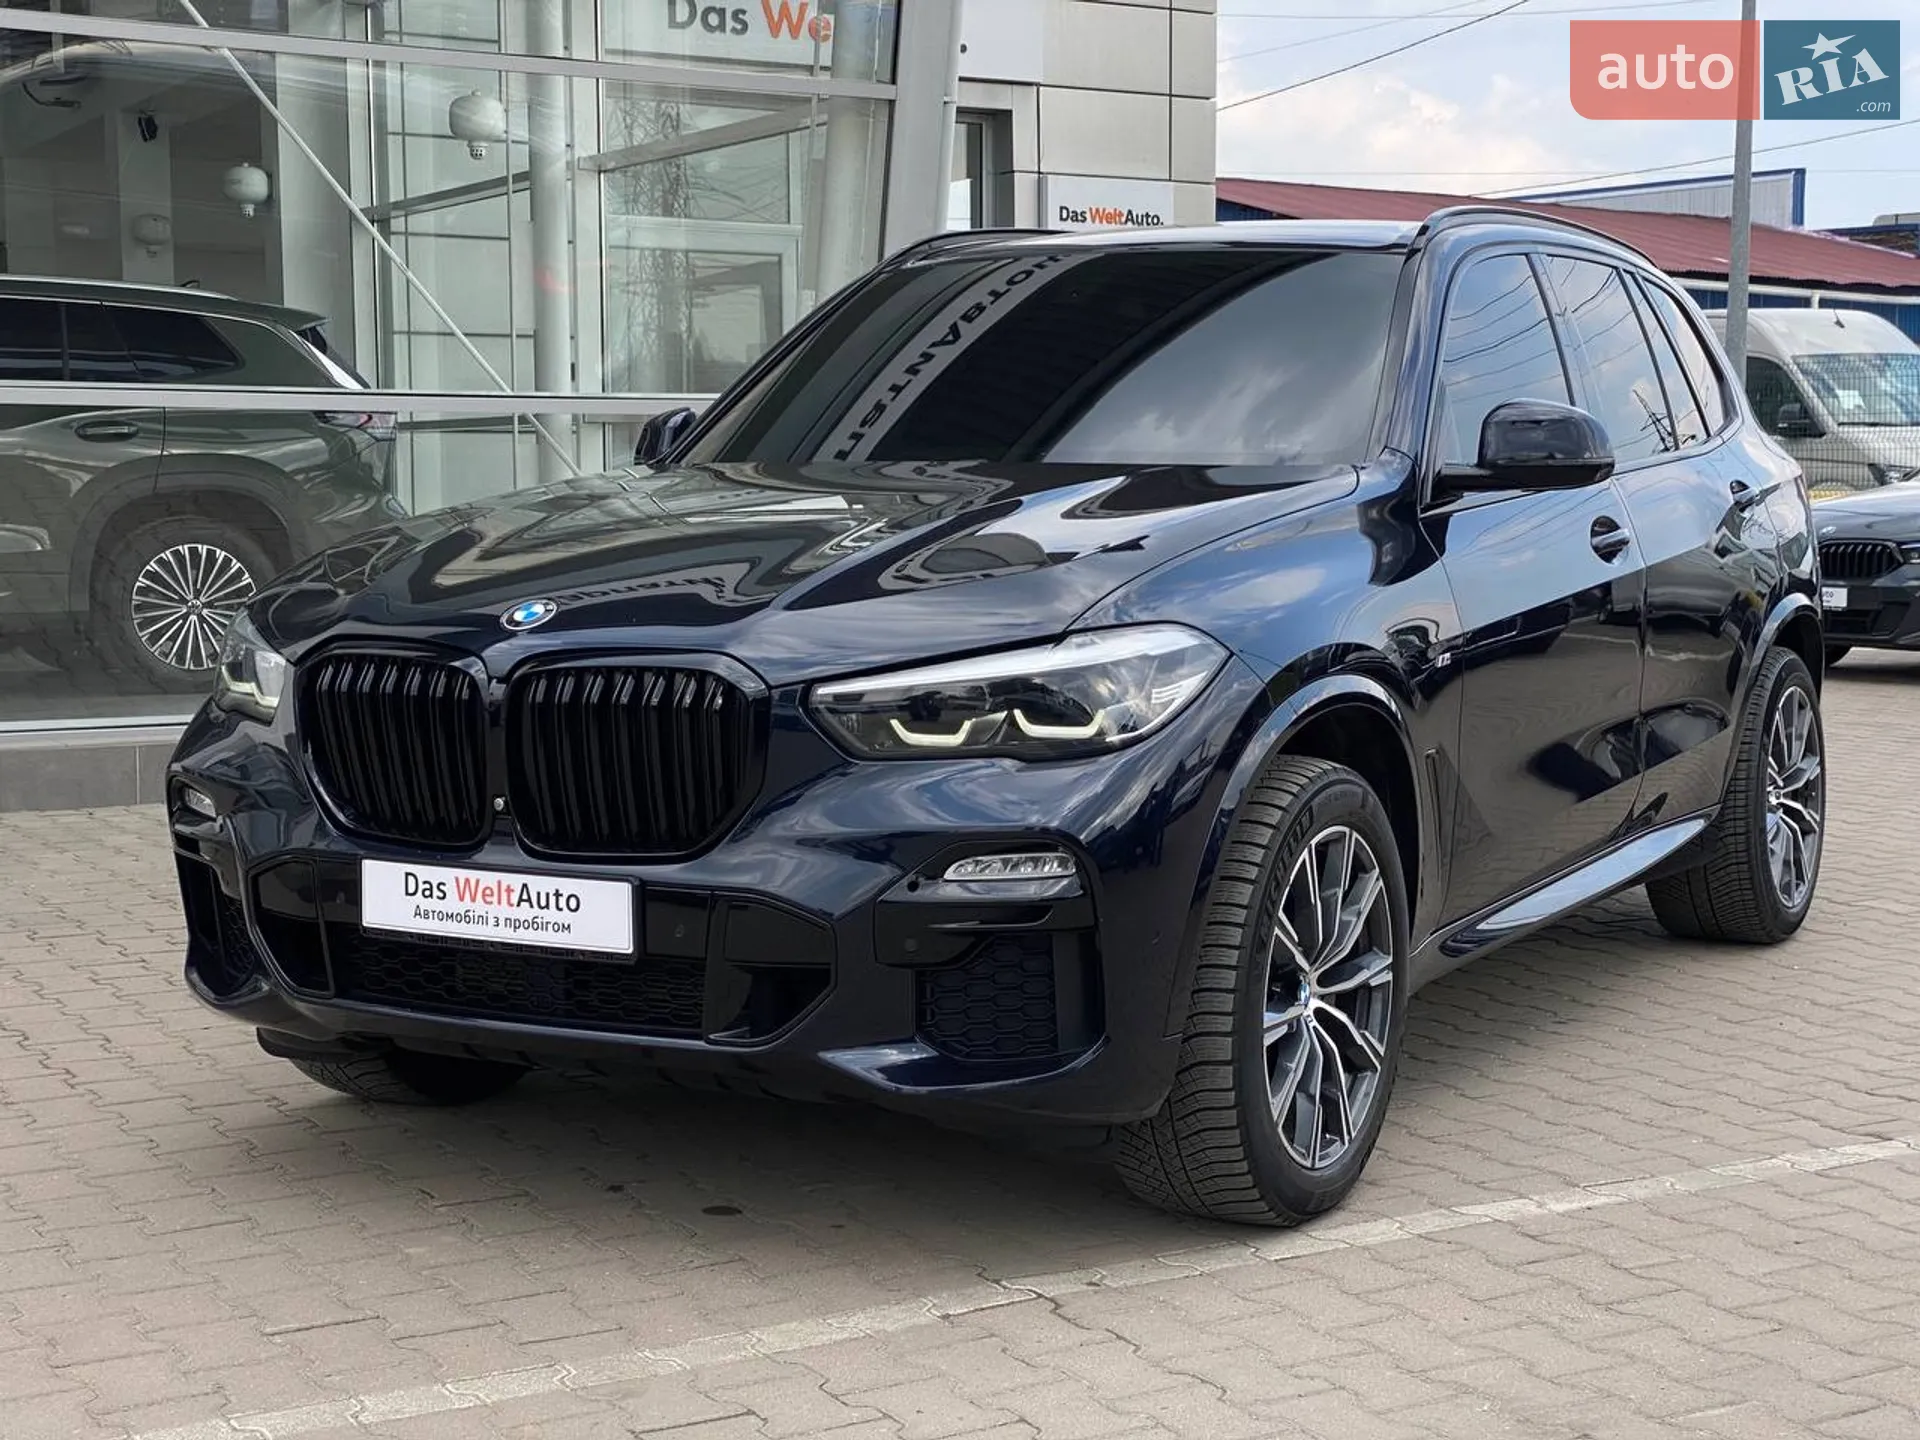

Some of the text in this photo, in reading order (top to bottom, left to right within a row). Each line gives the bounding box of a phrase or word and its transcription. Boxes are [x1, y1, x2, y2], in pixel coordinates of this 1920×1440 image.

[667, 0, 749, 36] Das
[1059, 206, 1164, 226] Das WeltAuto.
[404, 872, 581, 913] Das WeltAuto
[413, 905, 572, 934] Автомобілі з пробігом
